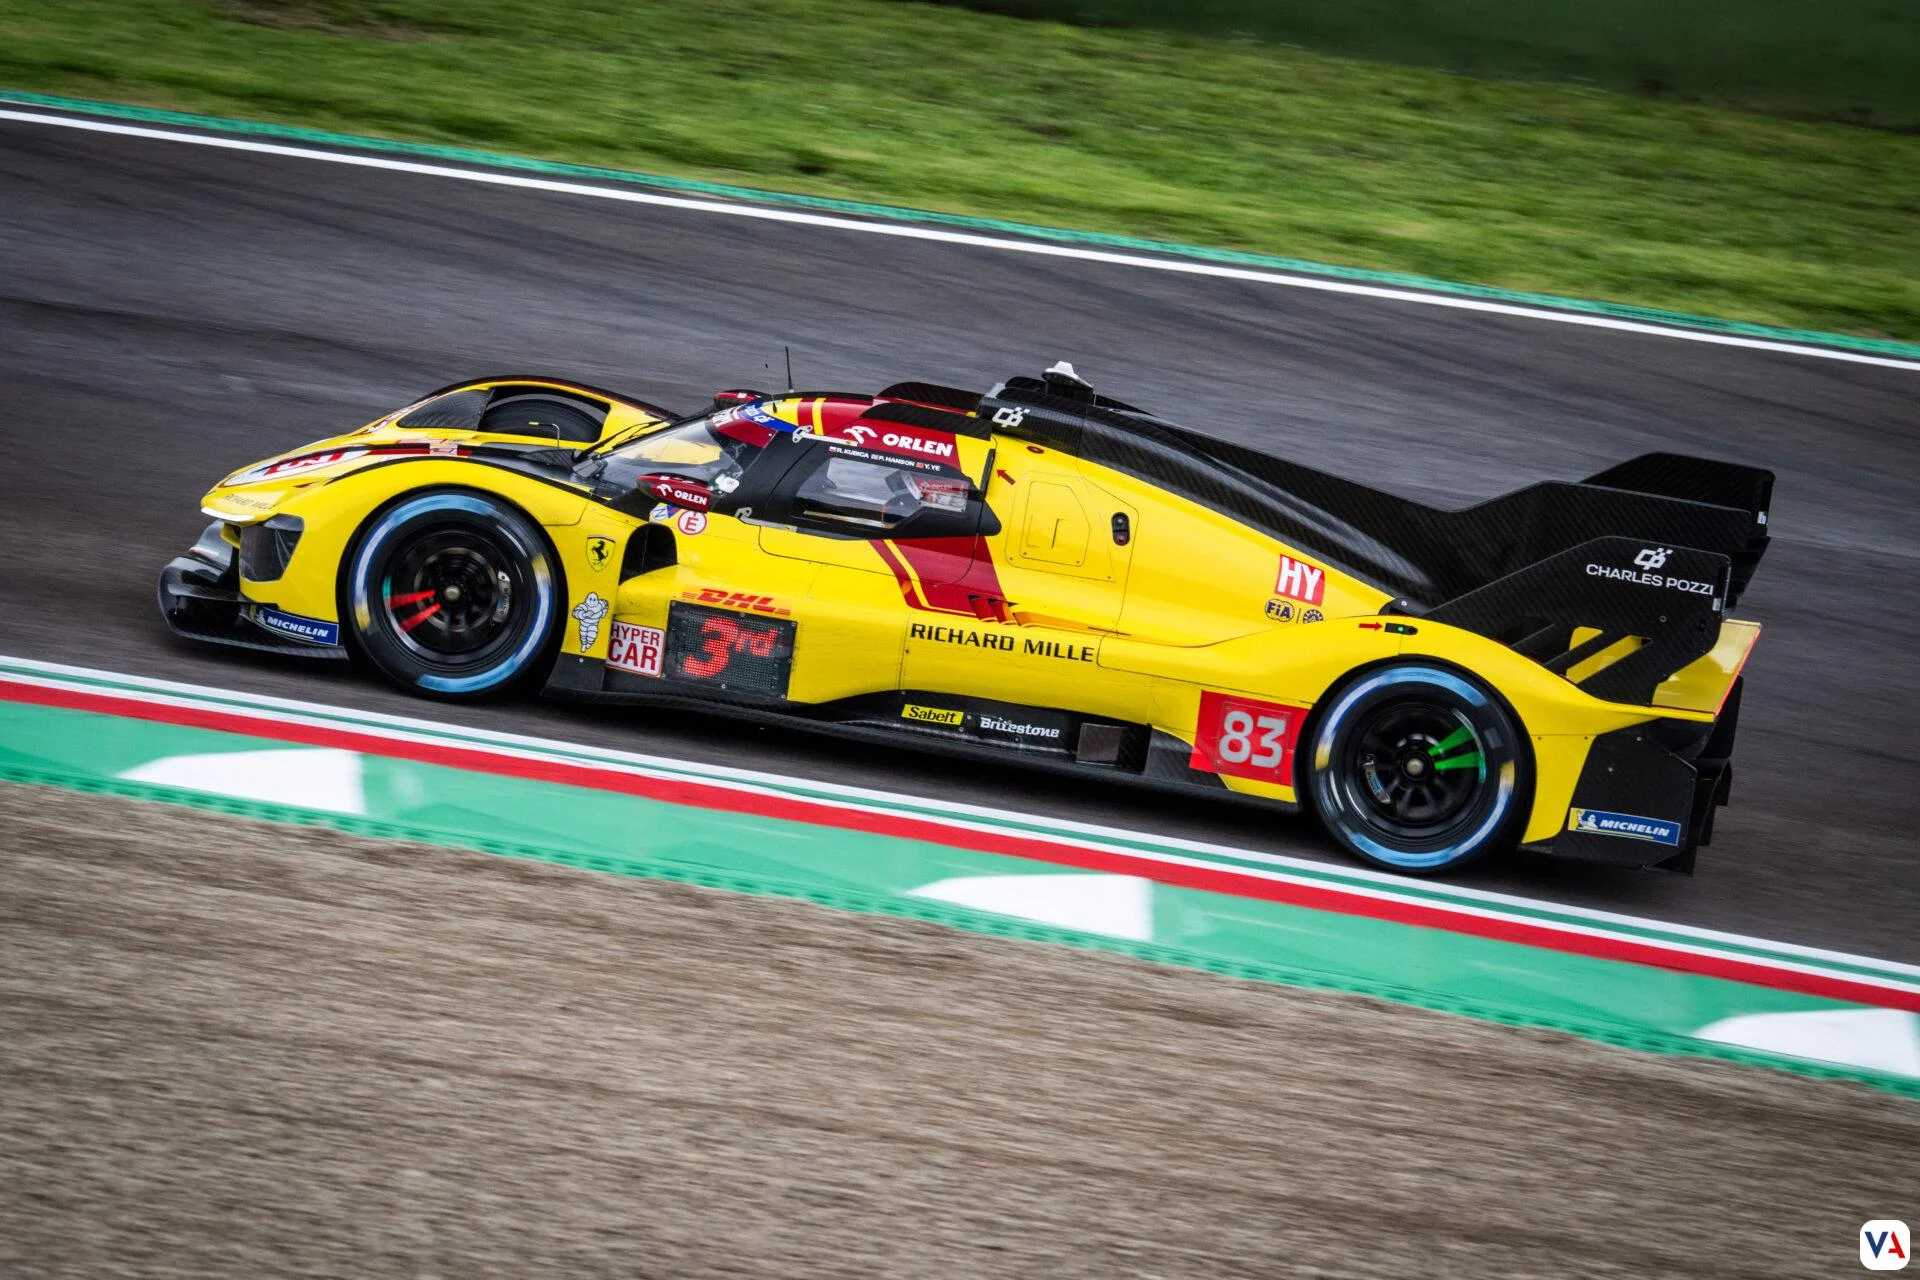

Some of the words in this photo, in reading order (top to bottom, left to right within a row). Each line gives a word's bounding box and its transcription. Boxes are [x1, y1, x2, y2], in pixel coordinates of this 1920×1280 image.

[882, 433, 953, 457] ORLEN
[674, 490, 708, 505] ORLEN
[685, 516, 699, 532] E
[1277, 556, 1322, 601] HY
[1586, 564, 1663, 587] CHARLES
[1666, 577, 1715, 596] POZZI
[697, 588, 777, 613] DHL
[267, 616, 329, 638] MICHELIN
[610, 623, 660, 647] HYPER
[608, 638, 658, 671] CAR
[682, 616, 779, 679] 3rd
[910, 622, 1015, 652] RICHARD
[1023, 638, 1095, 663] MILLE
[908, 706, 957, 724] Sabelt
[1218, 710, 1287, 769] 83
[1599, 819, 1670, 837] MICHELIN
